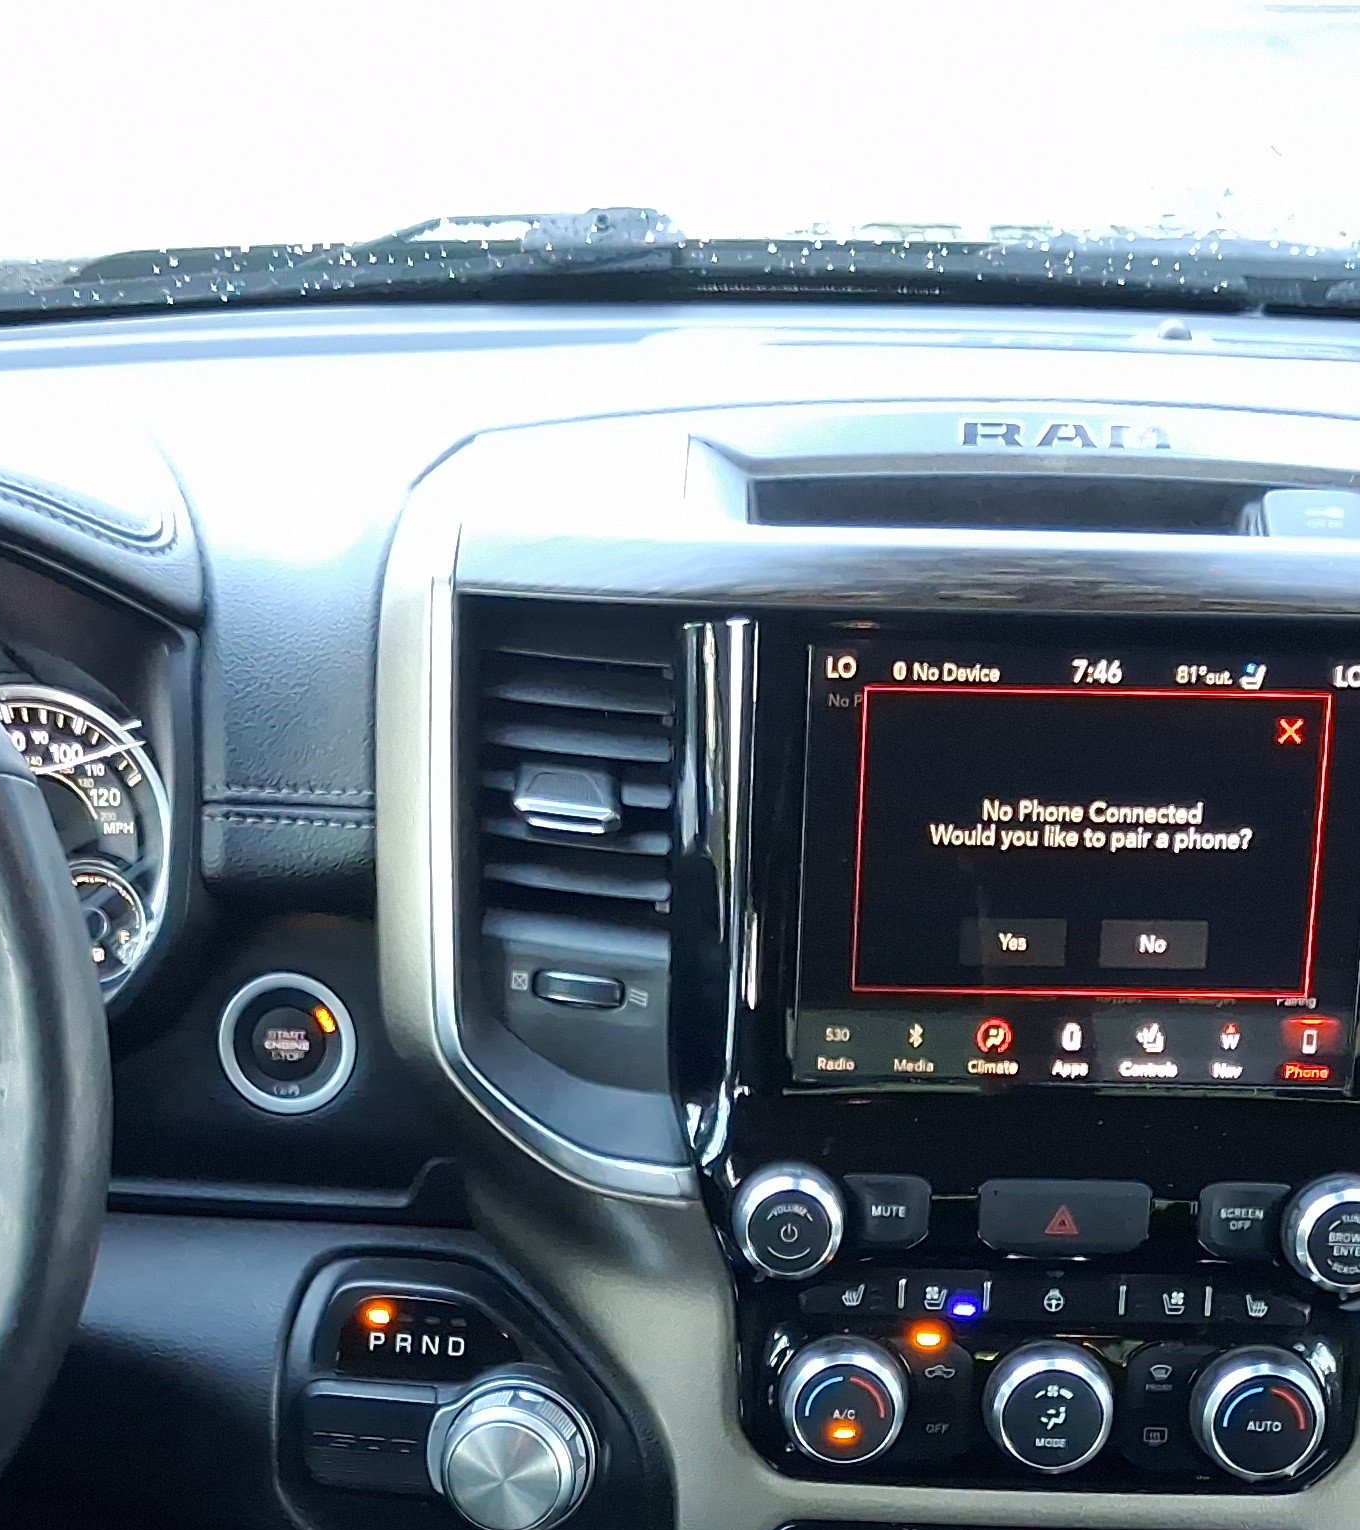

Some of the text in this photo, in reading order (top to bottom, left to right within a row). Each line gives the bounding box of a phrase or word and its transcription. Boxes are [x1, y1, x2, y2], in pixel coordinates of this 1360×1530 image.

[827, 655, 856, 679] LO
[913, 662, 939, 681] No
[943, 662, 1001, 683] Device
[1071, 658, 1123, 685] 7:46
[828, 693, 850, 708] No
[48, 742, 84, 764] 100
[89, 786, 121, 807] 120
[981, 799, 1204, 825] No Phone Connected
[102, 821, 135, 835] MPH
[929, 823, 1254, 854] Would you like to pair a phone?
[998, 931, 1028, 952] Yes
[1138, 933, 1168, 954] No
[817, 1056, 856, 1071] Radio
[893, 1058, 935, 1073] Media
[967, 1058, 1019, 1075] Climate
[1051, 1059, 1090, 1078] Apps
[1284, 1063, 1331, 1080] Phone
[871, 1204, 907, 1218] MUTE
[1220, 1207, 1264, 1220] SCREEN
[1229, 1220, 1252, 1231] OFF
[368, 1331, 465, 1357] P R N D
[832, 1409, 856, 1421] A/C
[925, 1423, 950, 1434] OFF
[1246, 1420, 1283, 1432] AUTO
[1035, 1438, 1067, 1449] MODE
